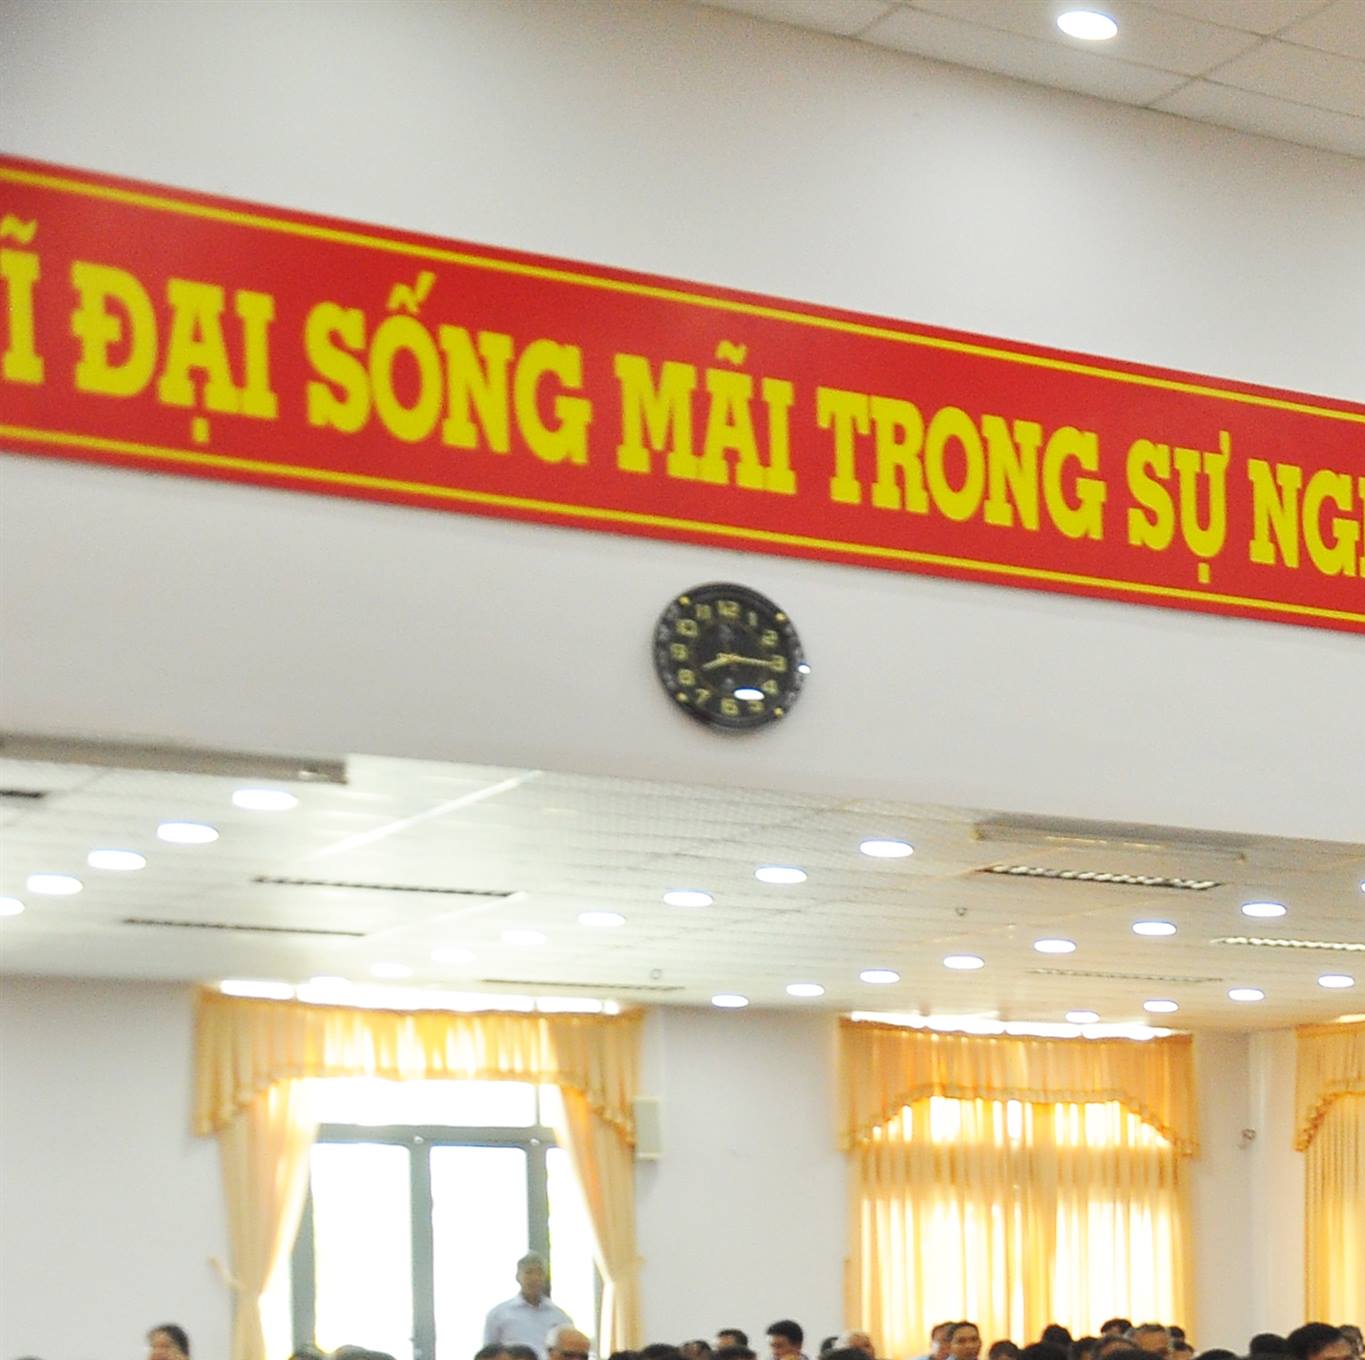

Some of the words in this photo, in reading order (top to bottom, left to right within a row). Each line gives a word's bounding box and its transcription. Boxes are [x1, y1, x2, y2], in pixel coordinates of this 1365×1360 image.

[70, 260, 278, 444] ĐẠI
[304, 271, 594, 466] SỐNG
[613, 339, 797, 496] MÃI
[815, 386, 1108, 541] TRONG
[1125, 430, 1232, 585] SỰ
